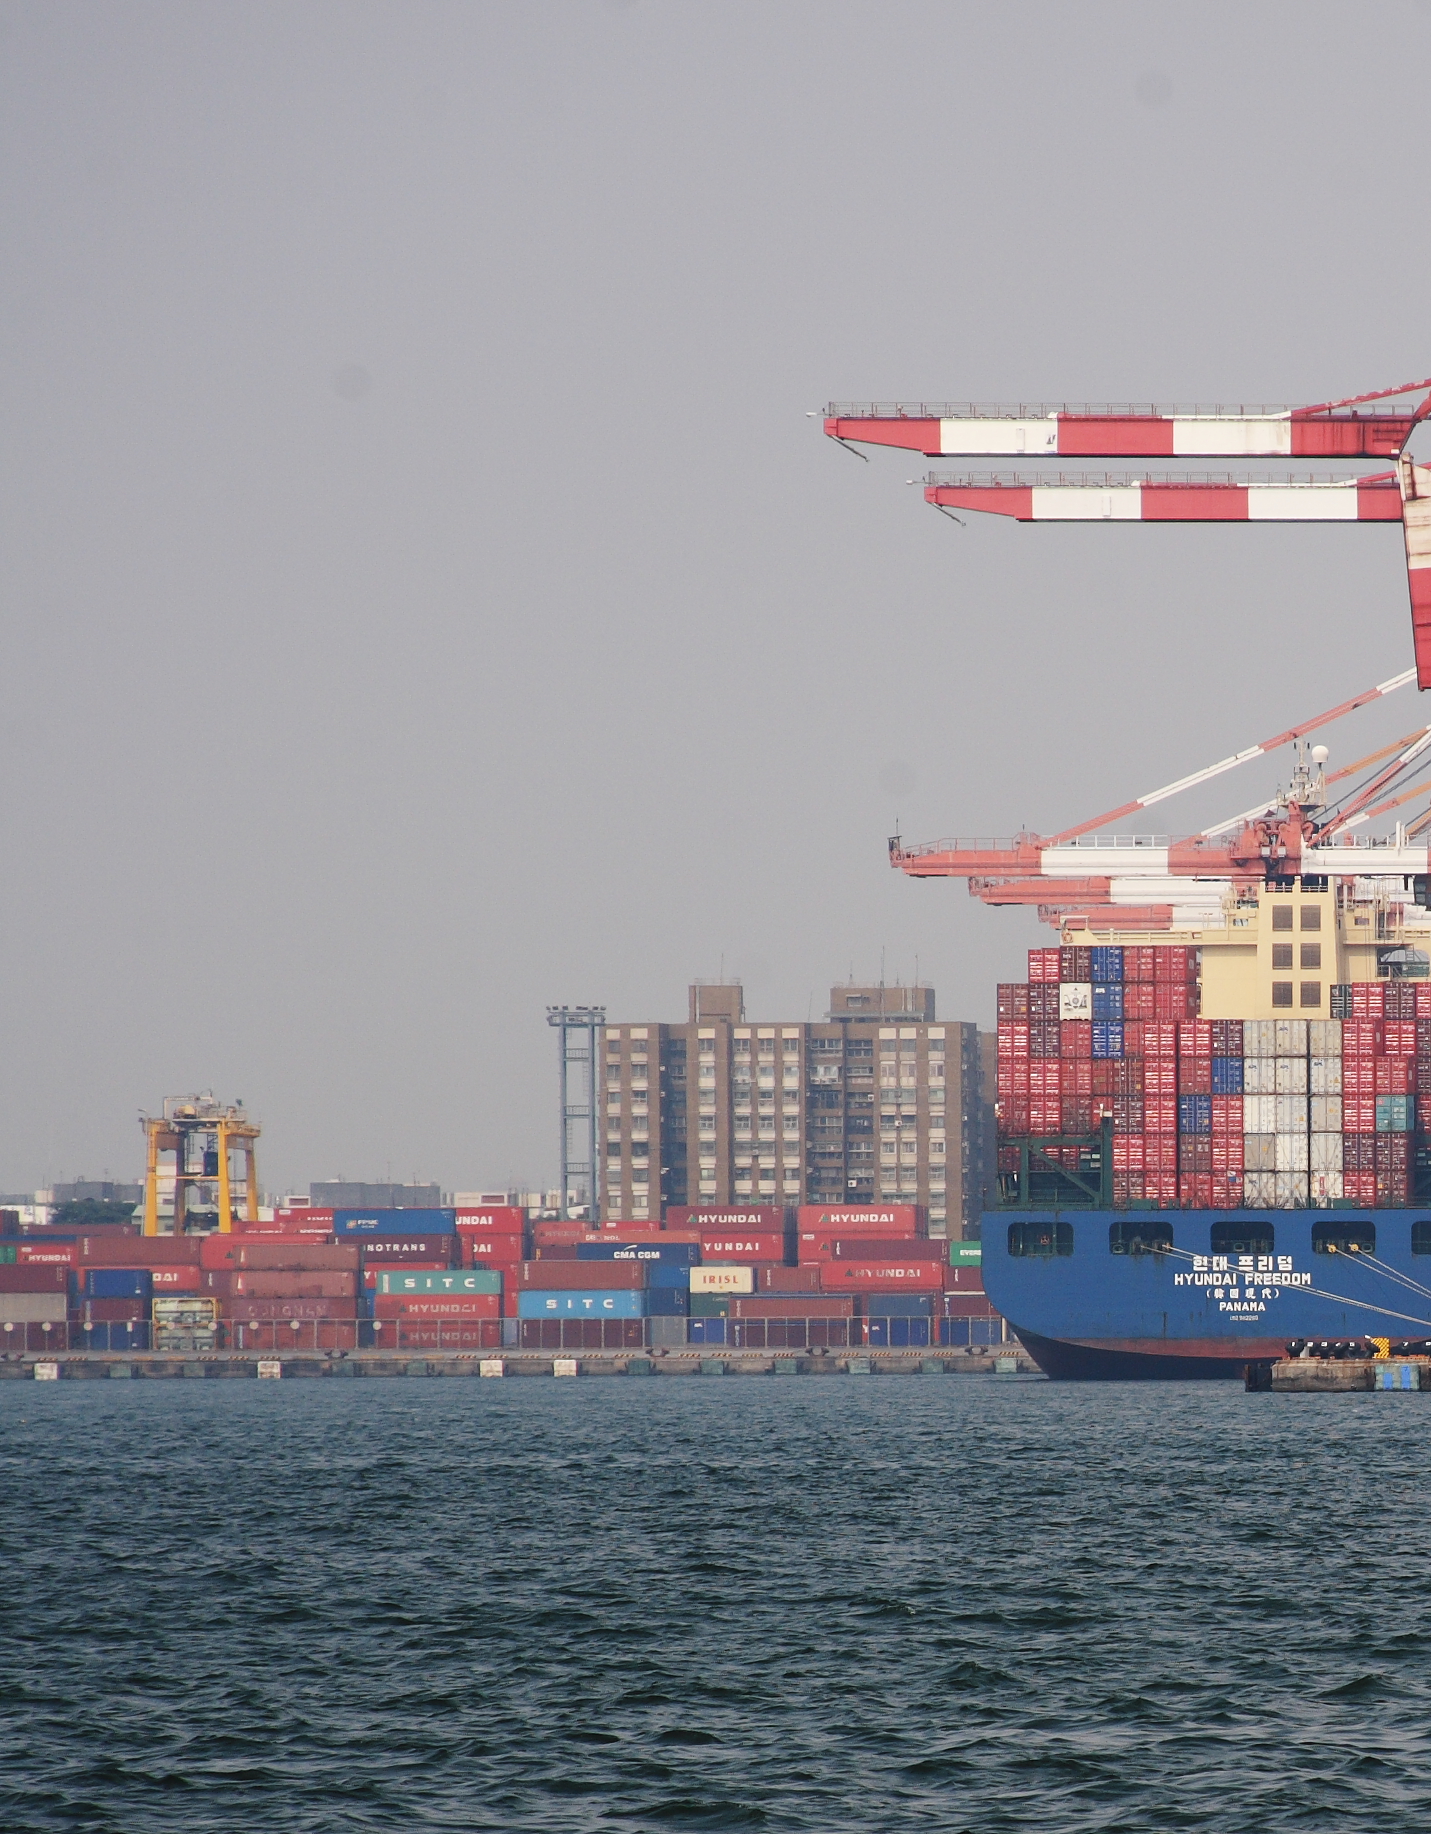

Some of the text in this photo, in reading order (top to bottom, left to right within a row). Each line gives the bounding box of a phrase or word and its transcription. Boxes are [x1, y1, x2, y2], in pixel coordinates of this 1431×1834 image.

[698, 1214, 761, 1223] HYUNDAI
[831, 1213, 894, 1222] HYUNDAI
[704, 1242, 759, 1251] YUNDAI
[613, 1251, 660, 1259] CMA CGM
[1192, 1255, 1293, 1271] 현대 프리덤
[404, 1278, 476, 1288] SITC
[703, 1275, 739, 1284] IRISL
[1174, 1272, 1311, 1286] HYUNDAI FREEDOM
[546, 1299, 614, 1309] SITC
[1219, 1301, 1266, 1312] PANAMA
